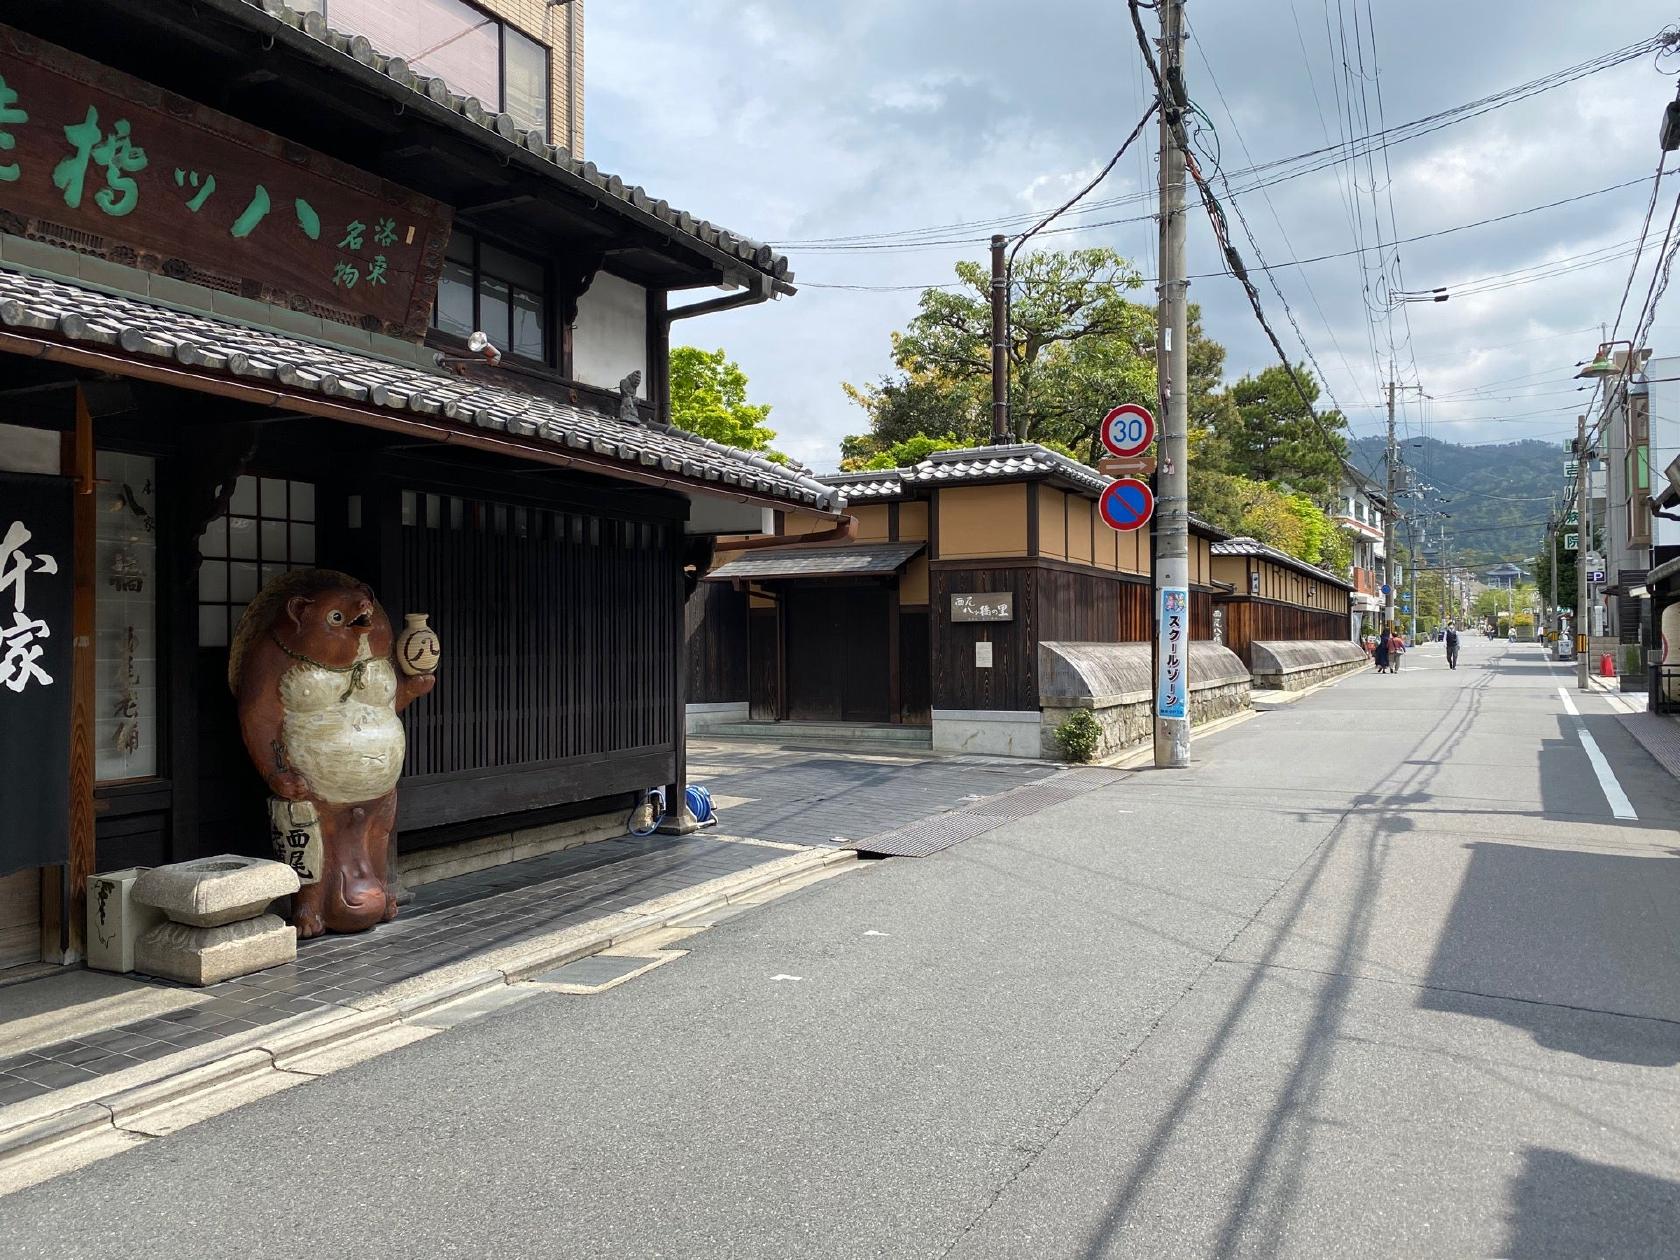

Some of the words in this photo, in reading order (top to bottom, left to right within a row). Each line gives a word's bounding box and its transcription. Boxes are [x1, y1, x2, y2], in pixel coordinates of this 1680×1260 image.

[332, 219, 367, 288] 名物
[1113, 419, 1142, 443] 30
[1593, 571, 1603, 581] P
[0, 520, 59, 693] 本家
[1166, 615, 1180, 708] スクールゾーン
[286, 828, 313, 879] 西尾
